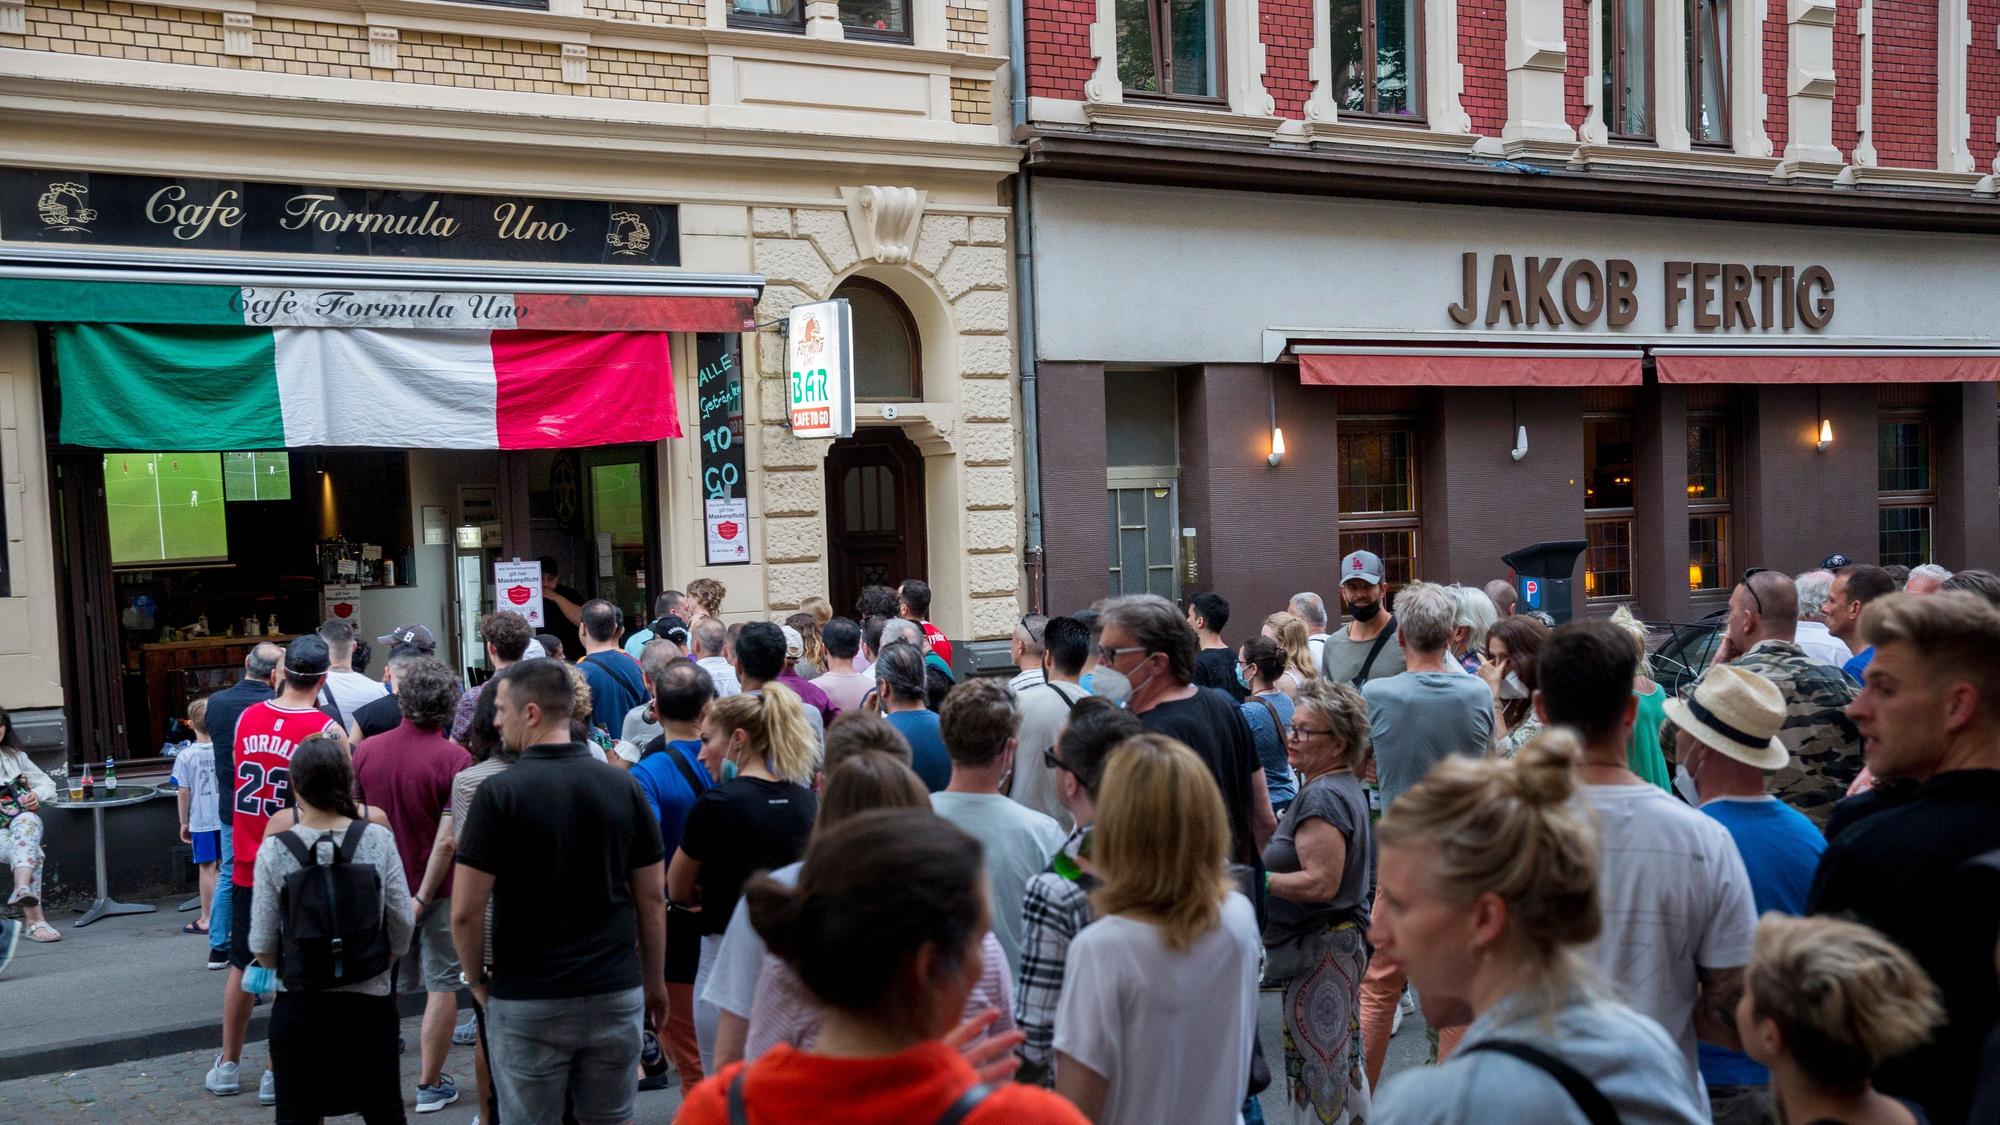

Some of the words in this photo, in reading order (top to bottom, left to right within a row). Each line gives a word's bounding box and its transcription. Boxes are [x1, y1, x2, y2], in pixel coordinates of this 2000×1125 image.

[145, 185, 247, 240] Cafe
[279, 194, 461, 237] Formula
[493, 202, 576, 242] Uno
[228, 287, 298, 324] Cafe
[316, 291, 455, 319] Formula
[468, 294, 528, 319] Uno
[1447, 252, 1639, 326] JAKOB
[1664, 261, 1836, 329] FERTIG
[699, 353, 733, 387] ALLE
[792, 368, 829, 403] BAR
[793, 410, 810, 427] CAFE
[810, 410, 819, 426] TO
[819, 410, 829, 425] GO
[703, 425, 732, 454] TO
[704, 462, 739, 494] GO
[708, 512, 746, 520] Maskenpflicht
[1527, 580, 1538, 602] P
[235, 760, 292, 819] 23
